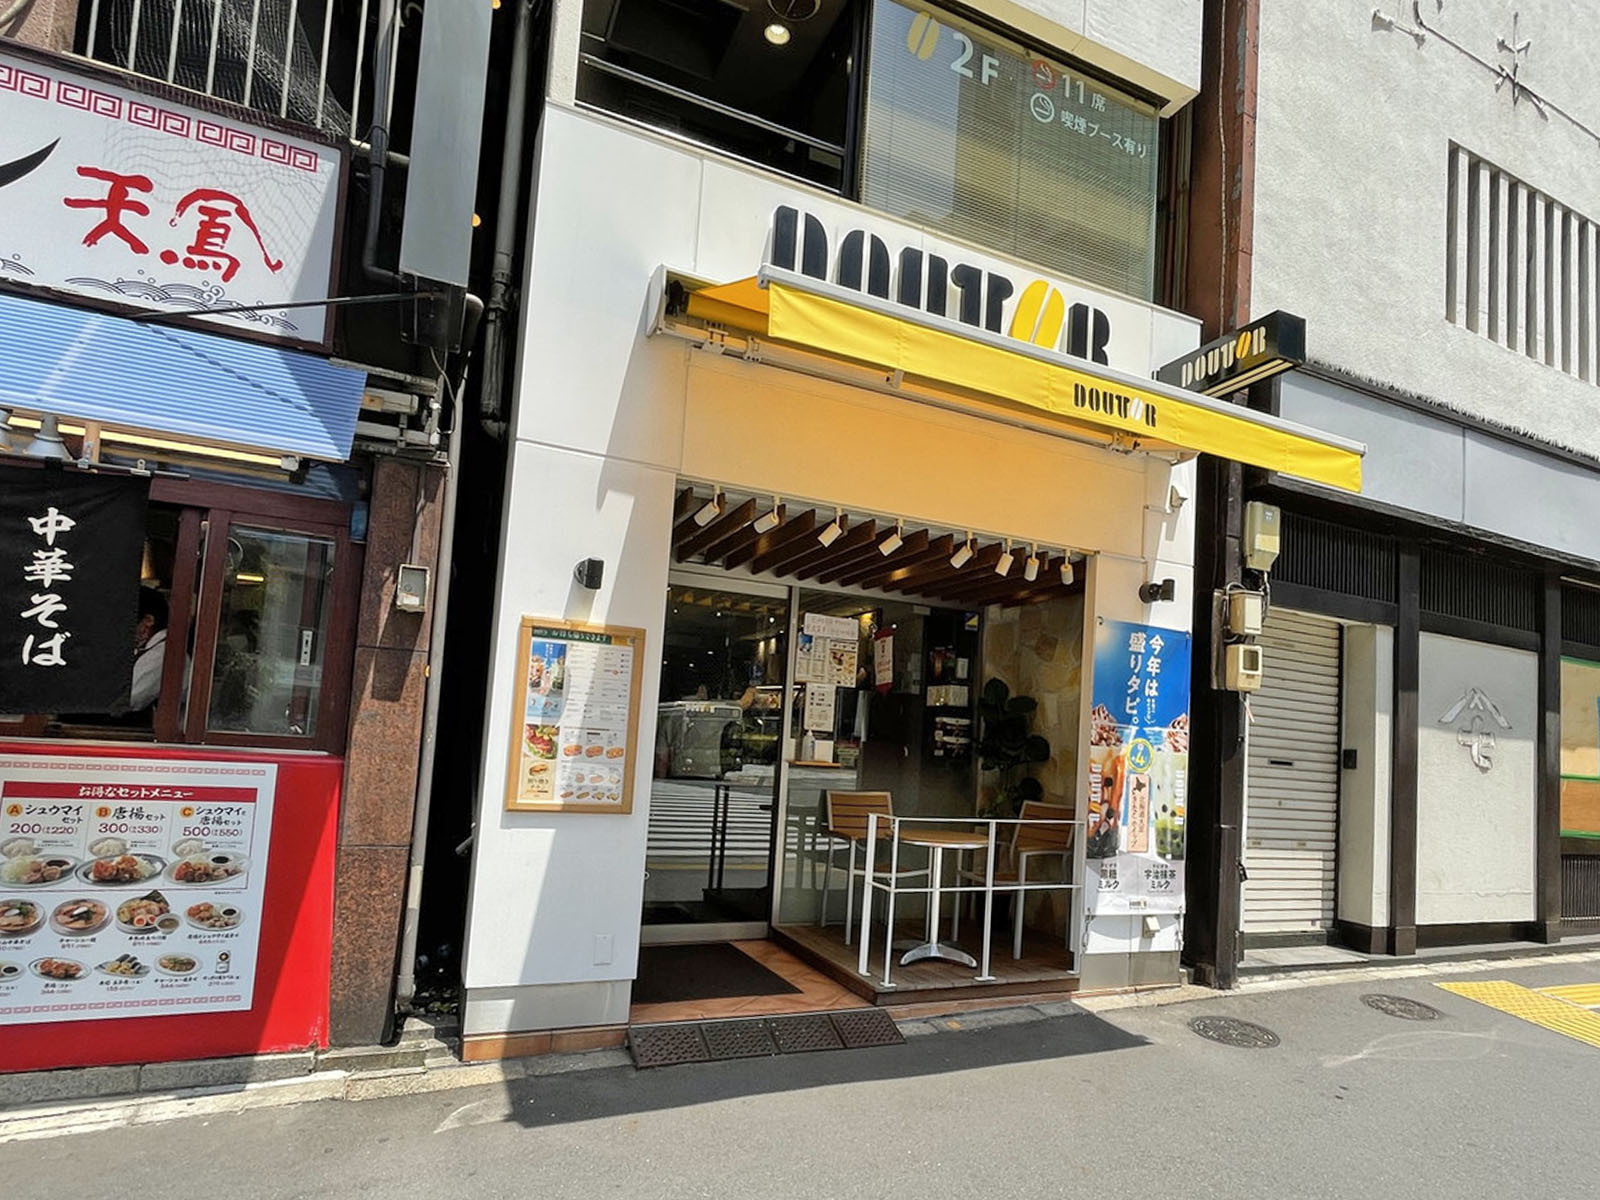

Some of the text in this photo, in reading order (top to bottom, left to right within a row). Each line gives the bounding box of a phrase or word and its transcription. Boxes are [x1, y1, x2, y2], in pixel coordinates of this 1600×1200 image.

[951, 33, 1000, 86] 2F
[1062, 74, 1106, 112] 11席
[1061, 110, 1148, 159] 喫煙ブース有り
[771, 205, 1110, 366] DOUTOR
[1181, 326, 1267, 388] DOUTOR
[1074, 383, 1157, 427] DOUTOR
[20, 507, 76, 667] 中華そば
[1125, 632, 1147, 725] 盛りタピ。
[1145, 634, 1164, 696] 今年は
[25, 804, 83, 816] シュウマイ
[79, 786, 194, 798] お得なセットメニュー
[62, 816, 83, 824] セット
[112, 806, 166, 821] 唐揚セット
[200, 816, 242, 826] 唐揚セット
[1098, 880, 1119, 890] ミルク
[1144, 869, 1176, 880] 宇治抹茶
[1151, 880, 1170, 890] ミルク
